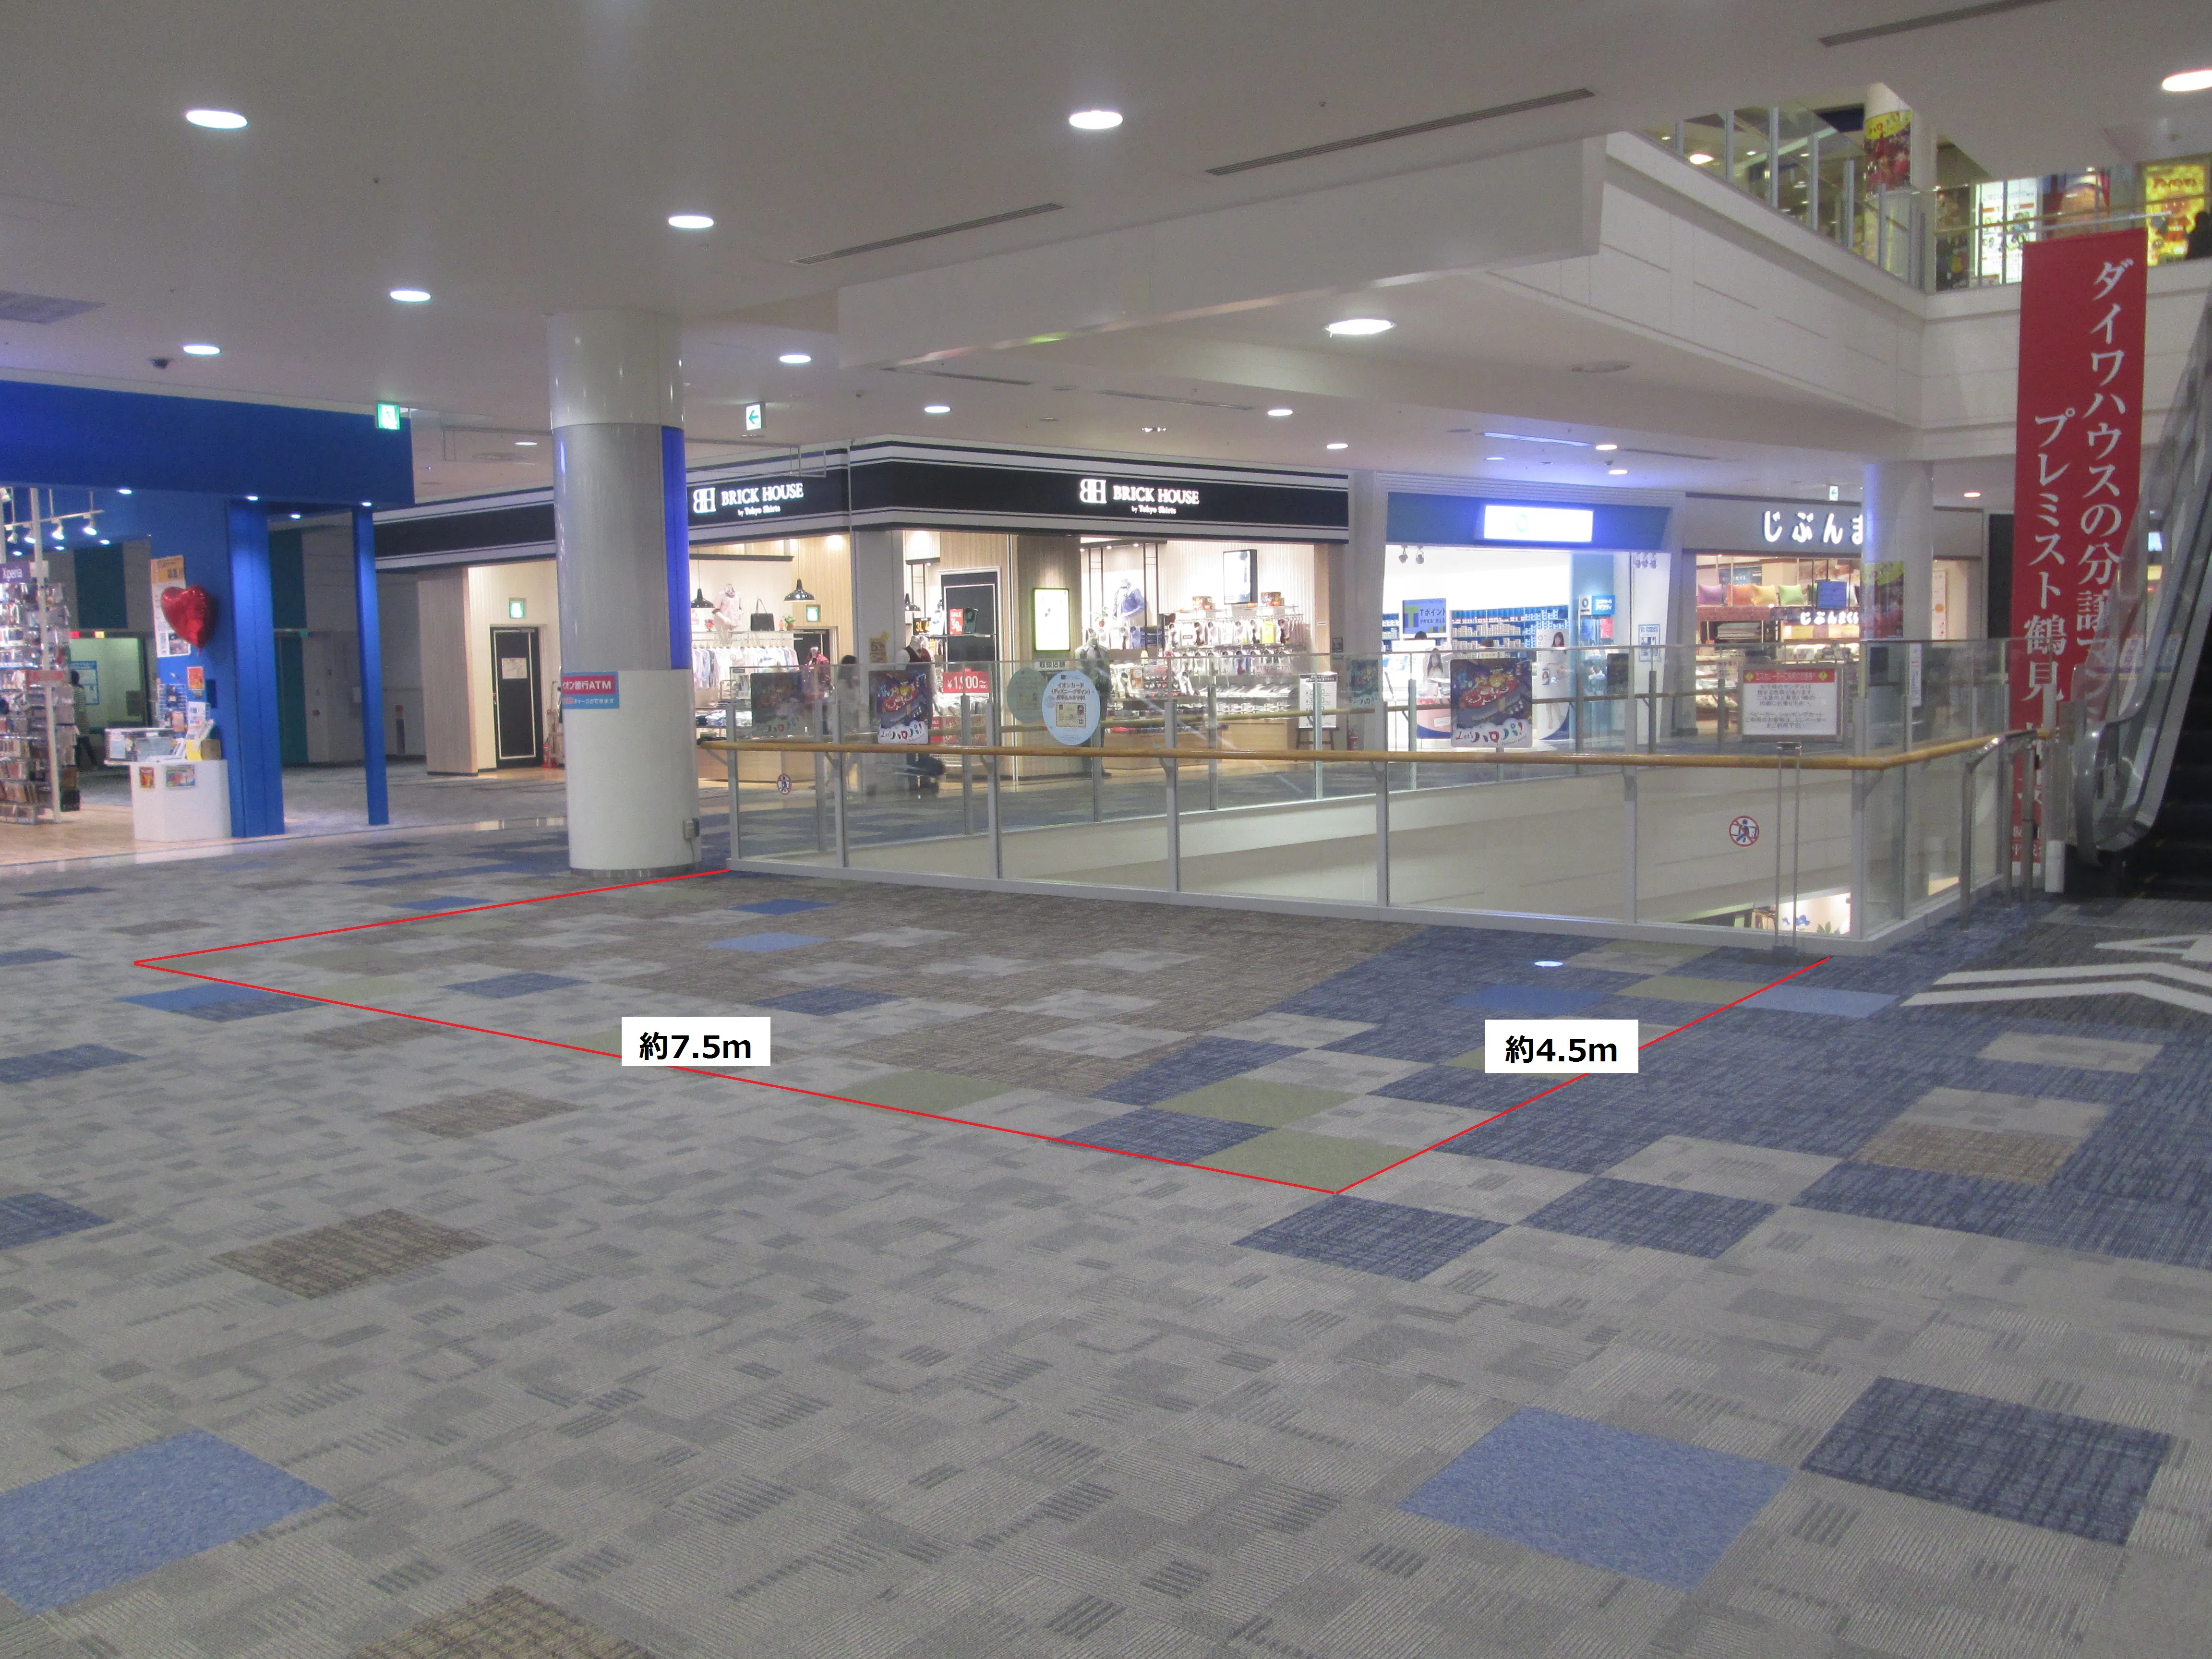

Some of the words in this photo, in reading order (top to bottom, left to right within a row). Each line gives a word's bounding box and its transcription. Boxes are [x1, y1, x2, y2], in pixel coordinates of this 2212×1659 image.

[721, 488, 760, 505] BRICK
[762, 483, 804, 502] HOUSE
[1113, 485, 1155, 502] BRICK
[1158, 488, 1200, 504] HOUSE
[745, 507, 762, 516] Tokyo
[763, 505, 781, 513] Shirts
[1139, 505, 1157, 514] Tokyo
[1158, 506, 1176, 514] Shirts
